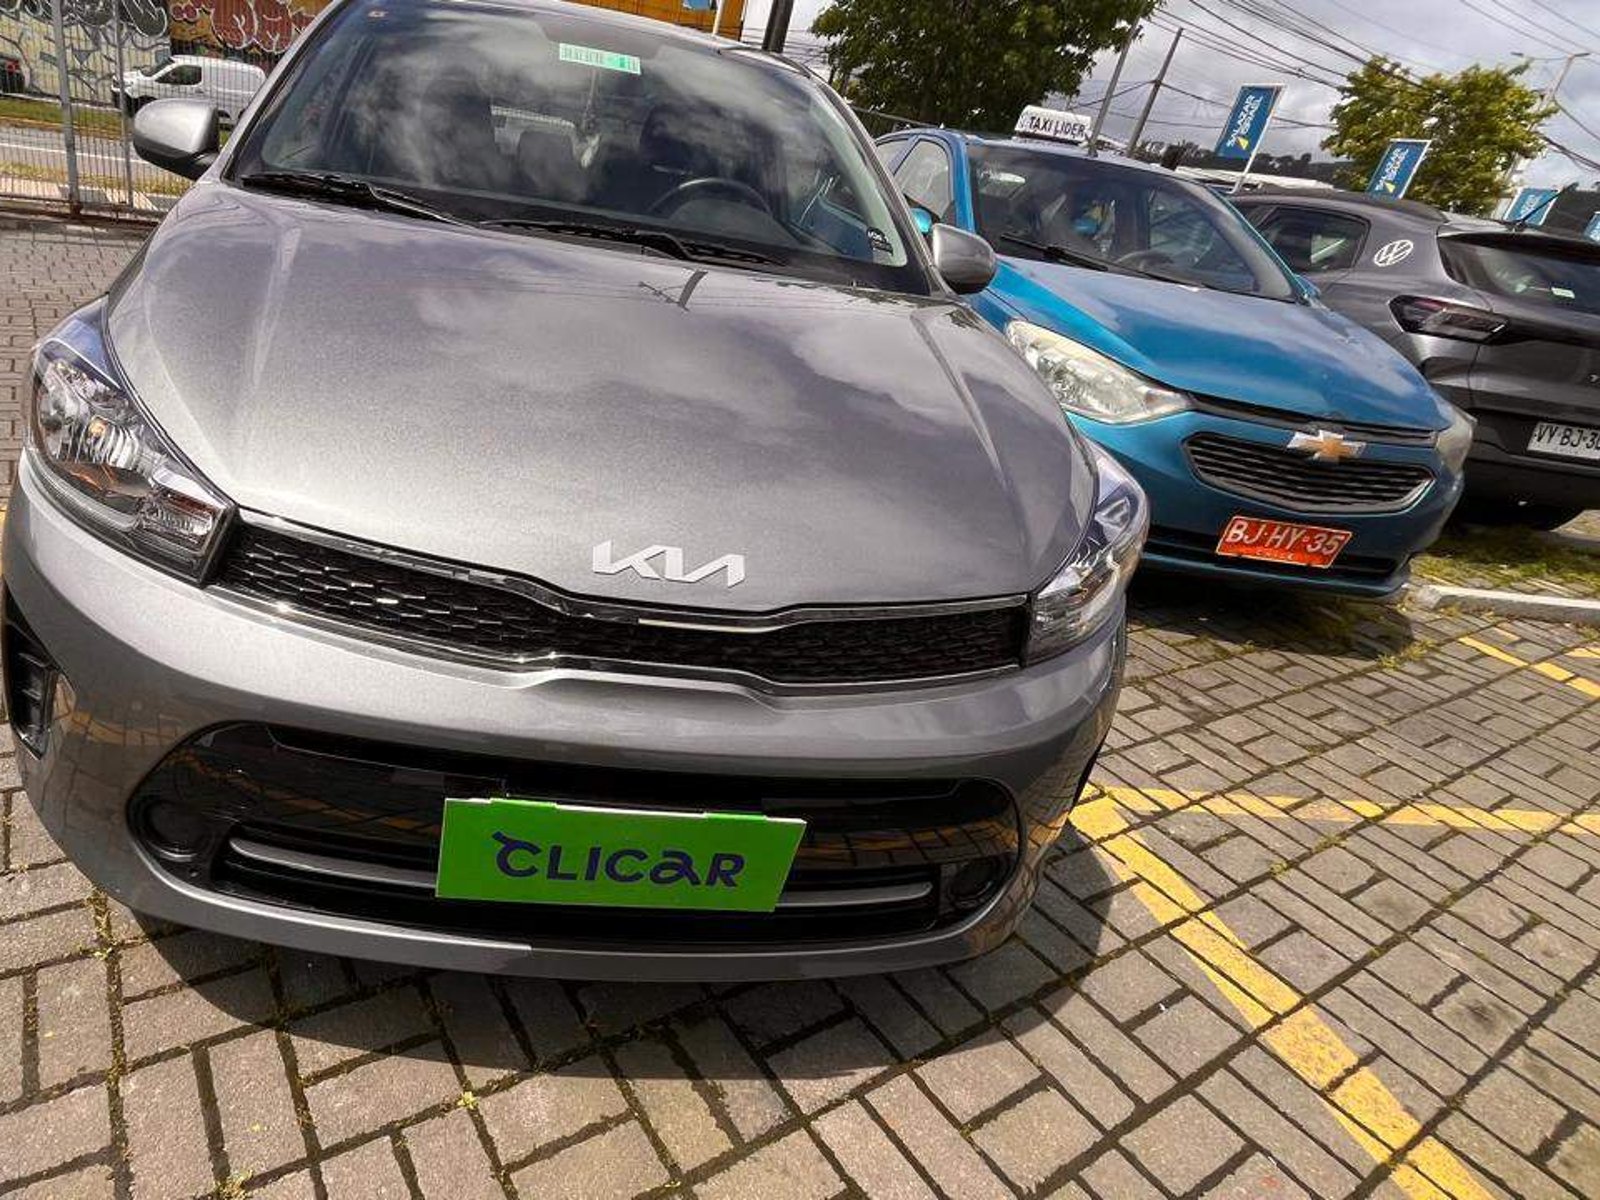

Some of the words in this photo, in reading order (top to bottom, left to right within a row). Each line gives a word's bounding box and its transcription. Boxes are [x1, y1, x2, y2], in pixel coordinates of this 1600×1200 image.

[1029, 116, 1053, 132] TAXI
[1054, 119, 1085, 138] LIDER
[592, 539, 746, 589] KIA
